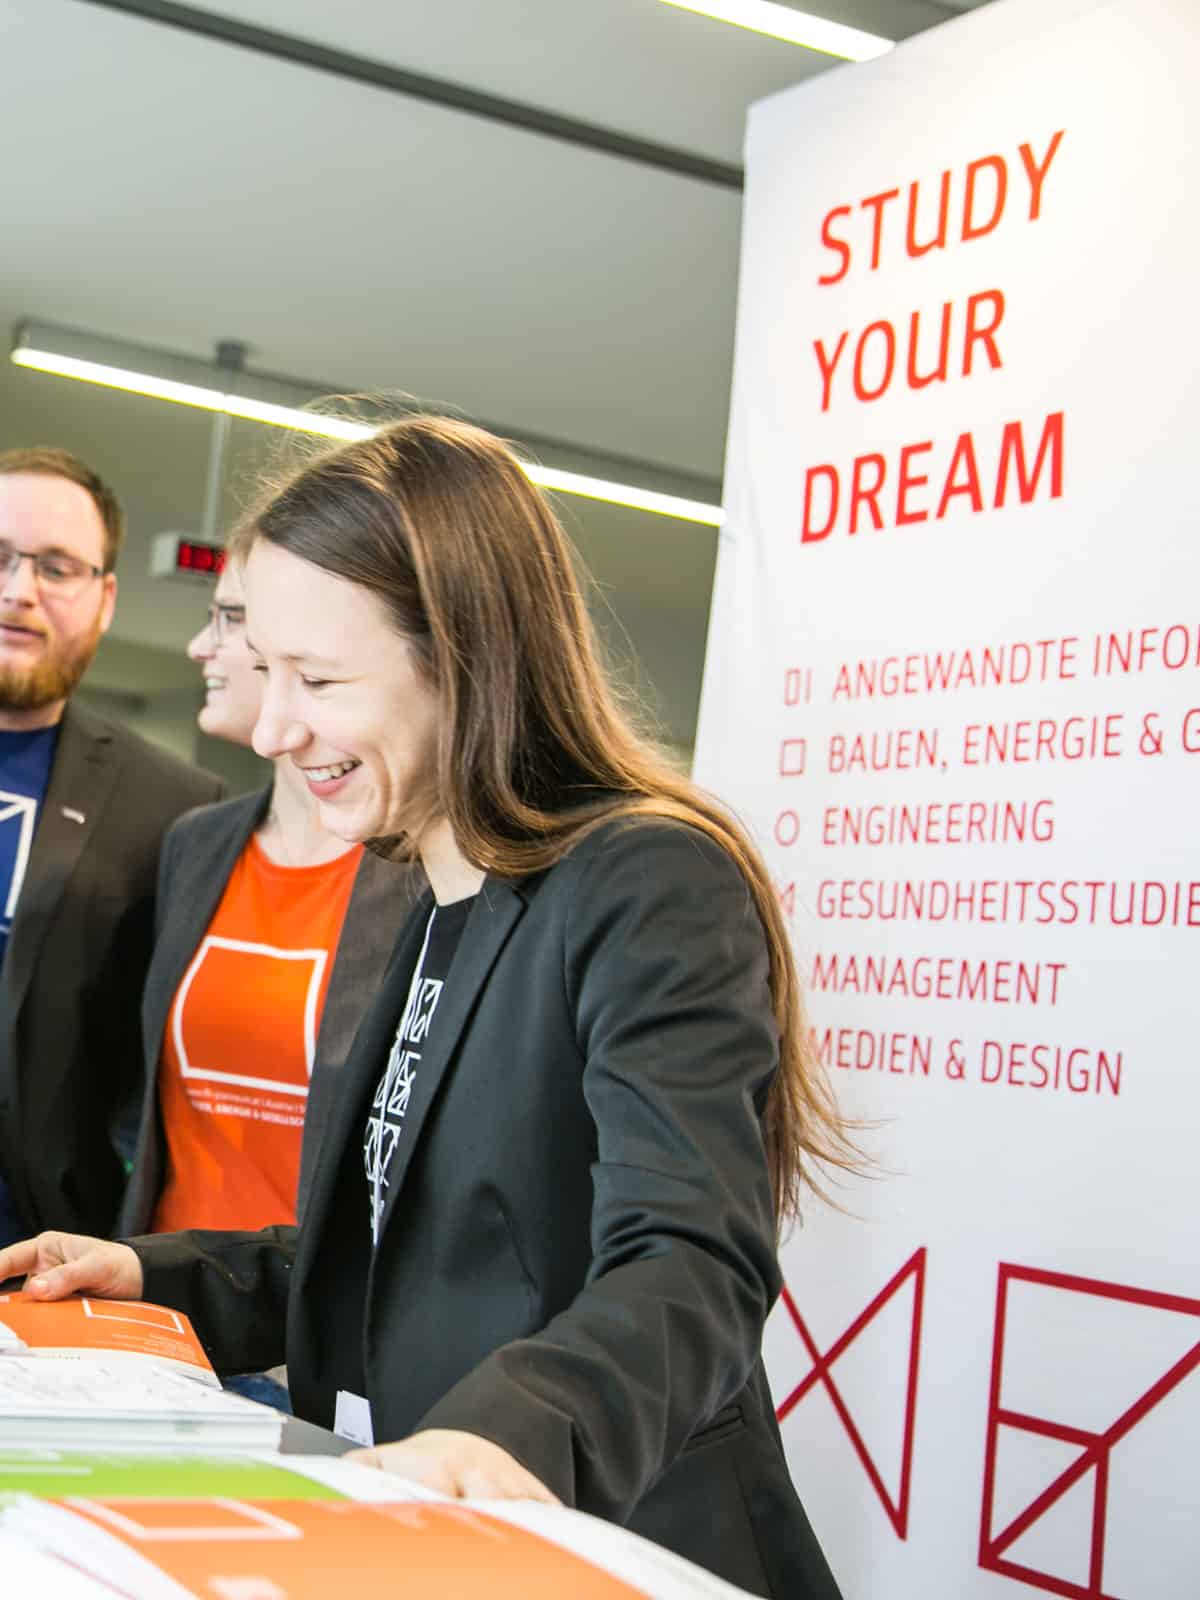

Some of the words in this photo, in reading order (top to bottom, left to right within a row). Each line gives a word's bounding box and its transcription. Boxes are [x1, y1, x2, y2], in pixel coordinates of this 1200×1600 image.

[817, 129, 1065, 286] STUDY
[812, 288, 1006, 413] YOUR
[800, 411, 1064, 544] DREAM
[832, 637, 1079, 702] ANGEWANDTE
[1094, 624, 1200, 676] INFO
[828, 728, 948, 774] BAUEN,
[963, 712, 1124, 766] ENERGIE
[1139, 711, 1162, 756] &
[822, 799, 1056, 847] ENGINEERING
[816, 879, 1200, 928] GESUNDHEITSSTUDIE
[811, 952, 1067, 1007] MANAGEMENT
[806, 1027, 932, 1077] MEDIEN
[945, 1039, 966, 1081] &
[981, 1039, 1123, 1097] DESIGN
